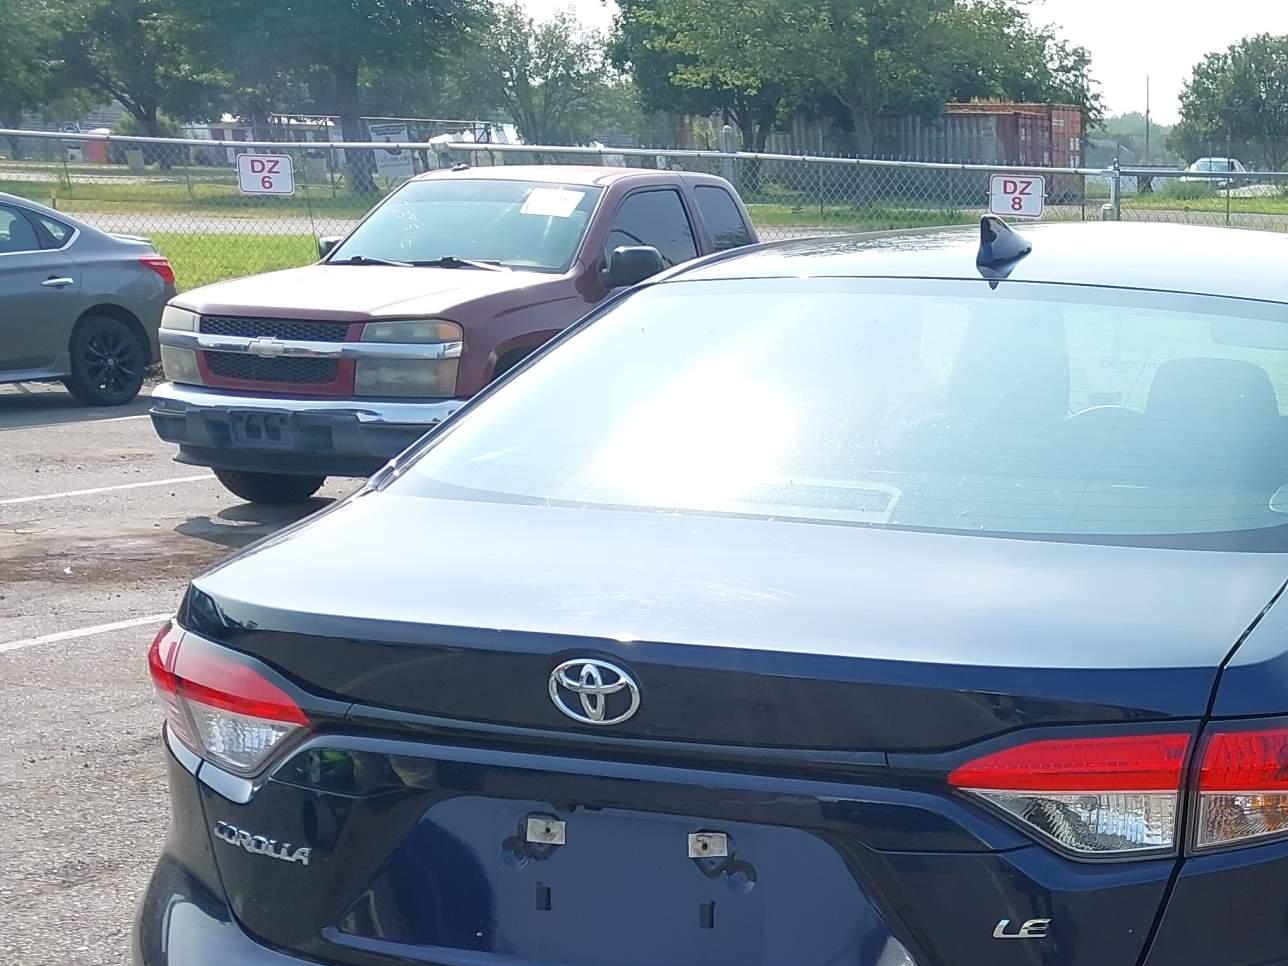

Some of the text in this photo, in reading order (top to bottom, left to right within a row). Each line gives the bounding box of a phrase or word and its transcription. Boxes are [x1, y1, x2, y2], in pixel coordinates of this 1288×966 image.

[250, 159, 281, 174] DZ
[261, 175, 273, 190] 6
[1002, 180, 1033, 196] DZ
[1010, 196, 1023, 211] 8
[213, 820, 313, 866] COROLLA
[992, 918, 1052, 938] LE
